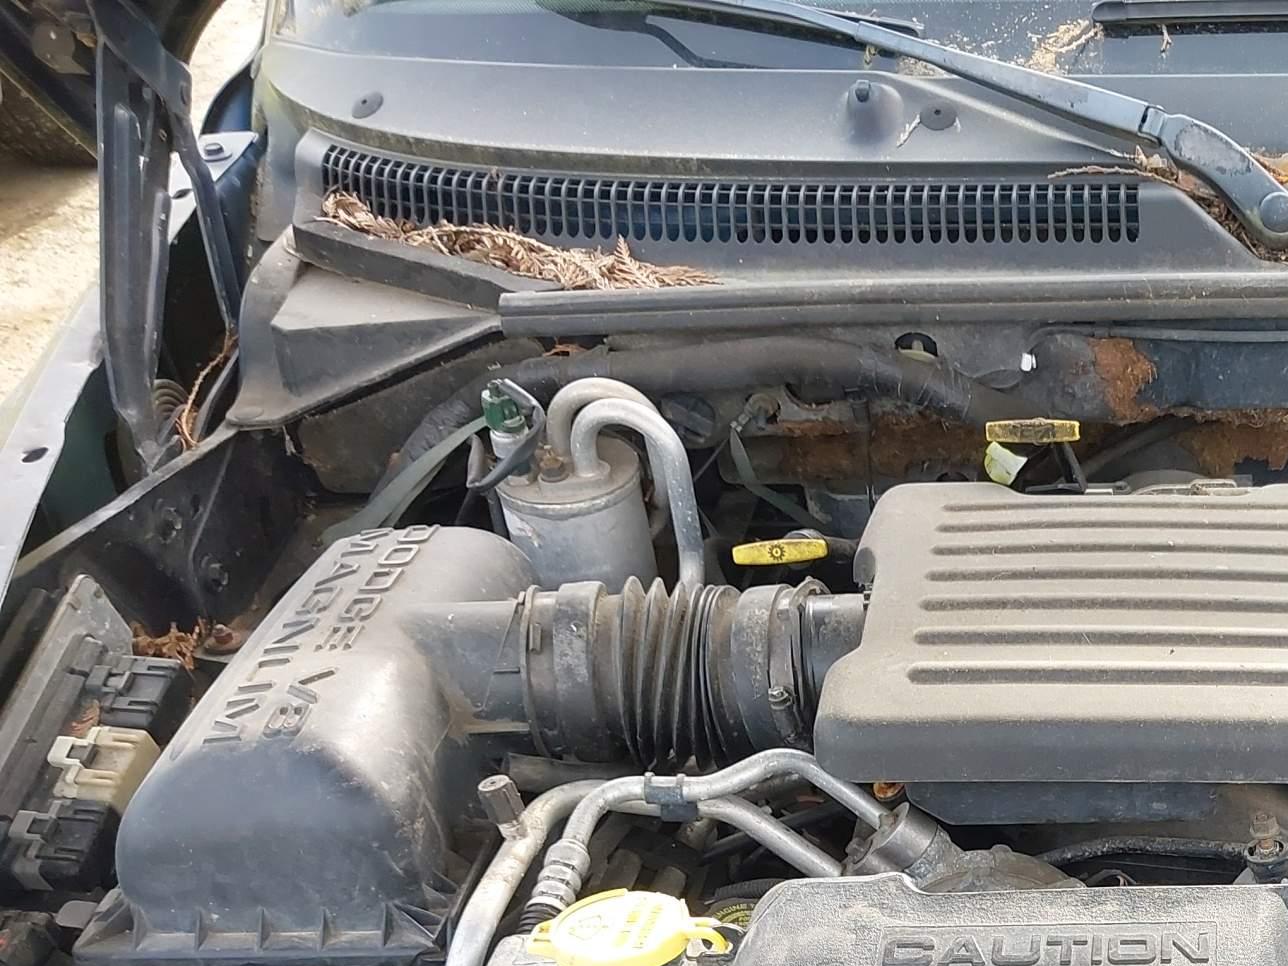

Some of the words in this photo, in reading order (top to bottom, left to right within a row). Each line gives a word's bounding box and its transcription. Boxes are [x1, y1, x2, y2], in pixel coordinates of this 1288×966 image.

[202, 527, 395, 745] MAGNUM
[314, 525, 440, 652] DODGE
[263, 667, 338, 739] V8
